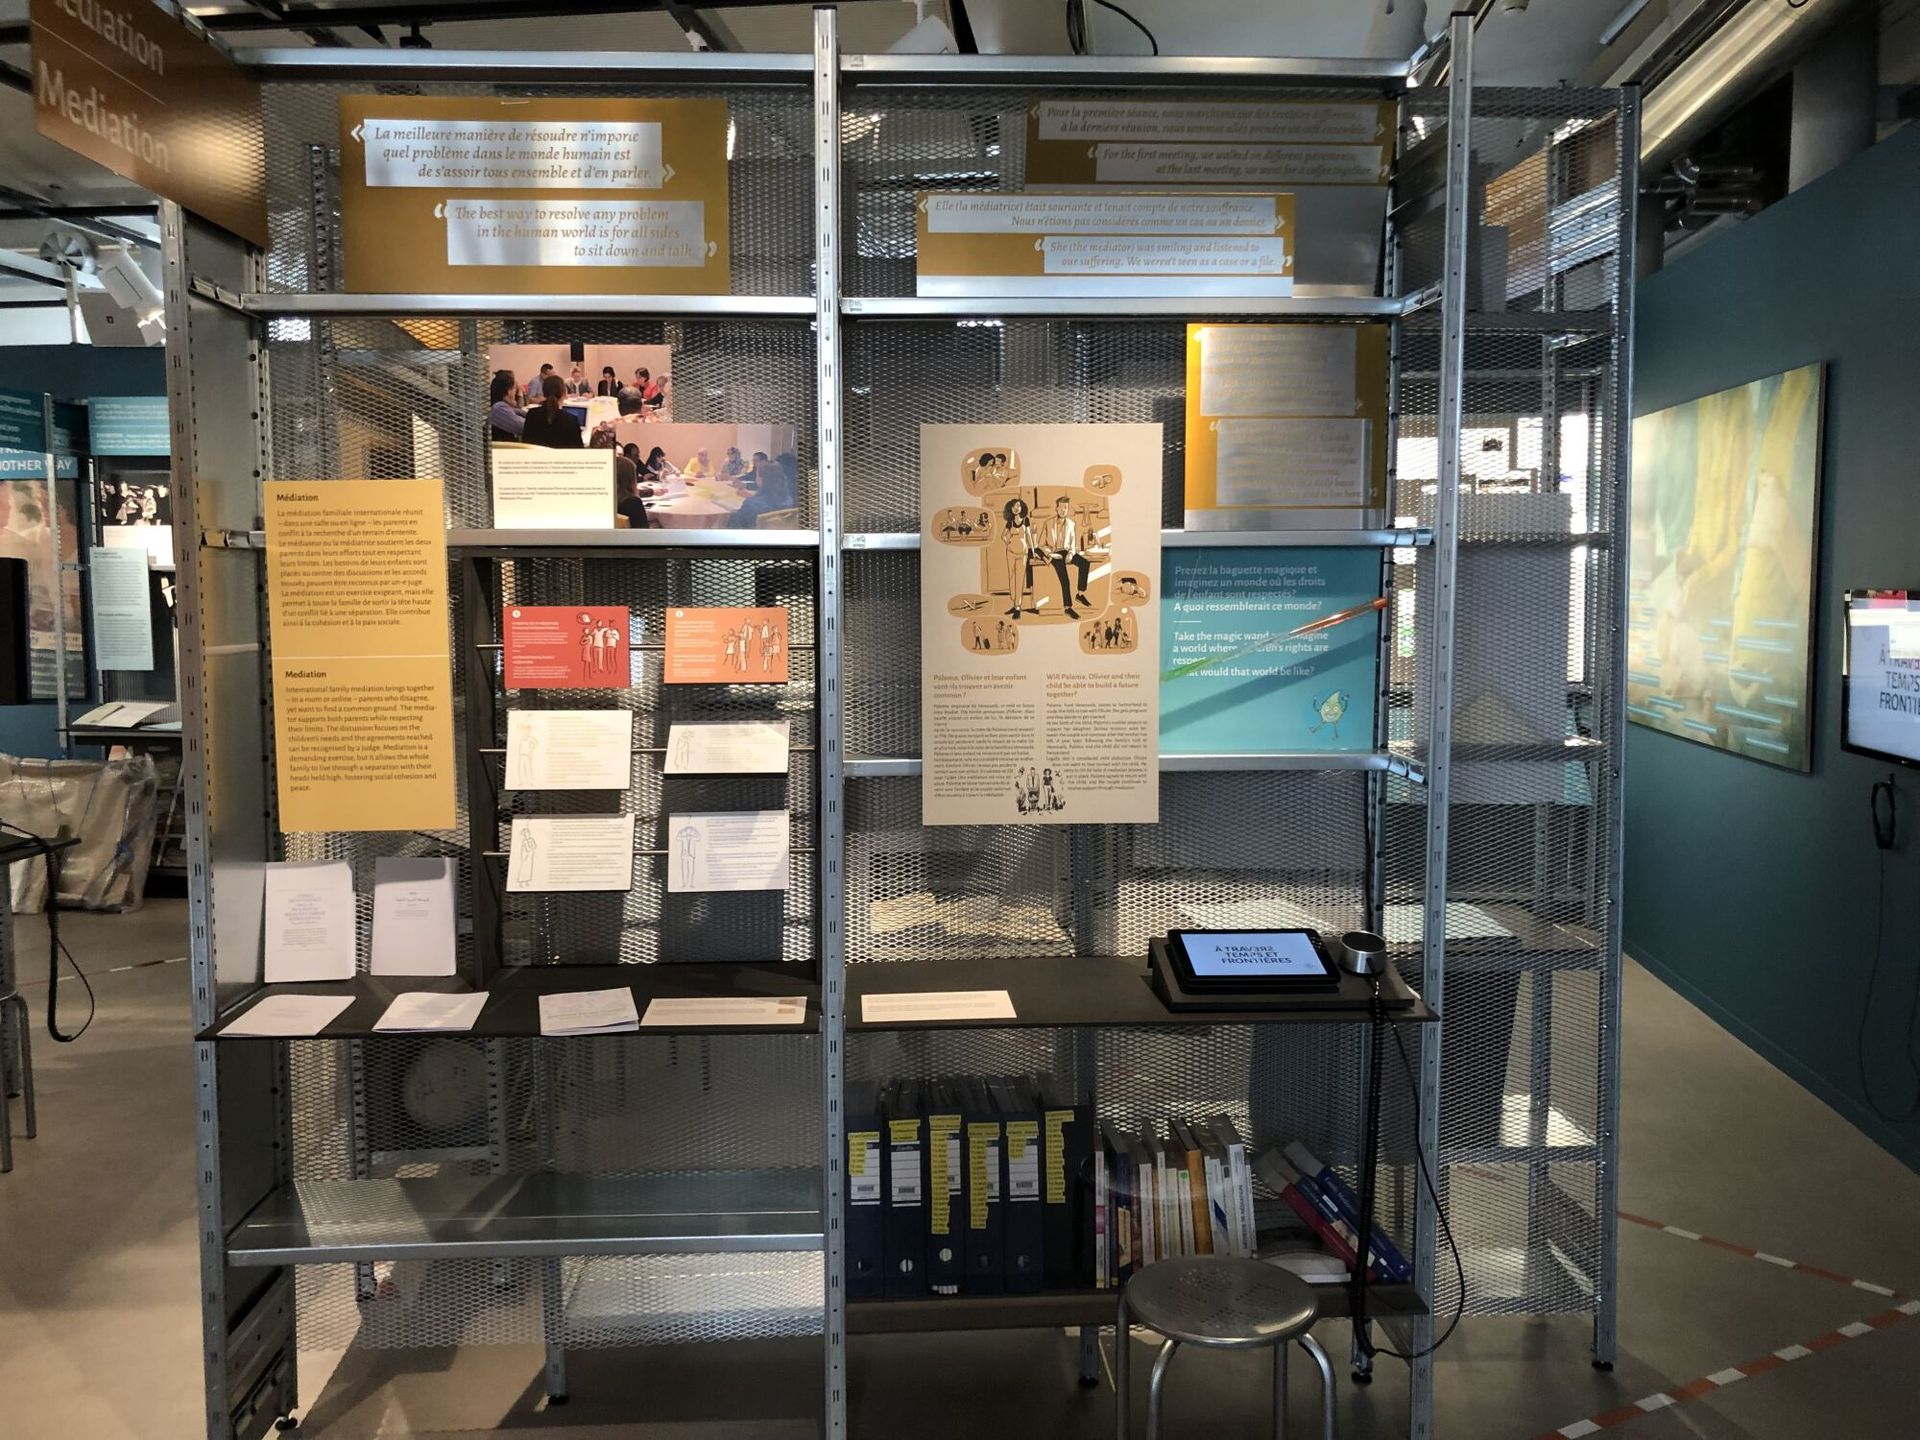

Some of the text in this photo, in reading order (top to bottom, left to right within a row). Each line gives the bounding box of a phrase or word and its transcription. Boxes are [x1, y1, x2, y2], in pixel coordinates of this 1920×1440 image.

[39, 59, 168, 173] Mediation
[375, 127, 391, 140] La
[393, 127, 454, 141] meilleure
[455, 128, 506, 142] manière
[508, 128, 522, 142] de
[524, 129, 577, 142] résoudre
[383, 146, 631, 162] quel problème dans le monde humain est
[1103, 149, 1120, 159] For
[1121, 148, 1135, 159] the
[1136, 149, 1157, 161] first
[418, 164, 652, 182] de s'assoir tous ensemble et d'en parler.
[935, 200, 954, 211] Elle
[956, 200, 968, 212] (la
[970, 201, 1023, 212] médiatrice)
[1025, 201, 1047, 211] était
[1048, 202, 1092, 212] souriante
[1094, 203, 1102, 212] et
[1104, 203, 1132, 212] tenait
[1134, 203, 1165, 214] compte
[1167, 200, 1178, 212] de
[456, 206, 669, 223] The best way to resolve any problem
[477, 225, 680, 242] in the human world is for all sides
[574, 245, 585, 257] to
[587, 244, 602, 257] sit
[605, 244, 639, 257] down
[641, 244, 665, 257] and
[1050, 242, 1260, 255] She (the mediator) was smiling and listened to
[277, 493, 319, 502] Médiation
[1175, 565, 1318, 577] Prenez la baguette magique et
[1175, 577, 1326, 588] imaginez un monde où les droits
[1174, 590, 1186, 600] de
[1223, 590, 1246, 600] sont
[1173, 601, 1322, 613] A quoi ressemblerait ce monde?
[1174, 631, 1195, 641] Take
[1196, 631, 1212, 641] the
[1214, 631, 1242, 643] magic
[1244, 631, 1270, 641] wand
[1180, 643, 1207, 653] world
[1285, 643, 1312, 654] rights
[285, 671, 327, 679] Mediation
[1046, 672, 1140, 681] Will Paloma, Olivier and their
[1200, 666, 1229, 676] would
[1230, 666, 1250, 676] that
[1252, 666, 1278, 676] world
[1280, 667, 1291, 676] be
[1292, 666, 1315, 676] like?
[1046, 681, 1062, 689] child
[1063, 681, 1071, 689] be
[1072, 681, 1087, 689] able
[1095, 681, 1112, 689] build
[1119, 680, 1138, 689] future
[1046, 690, 1078, 699] together?
